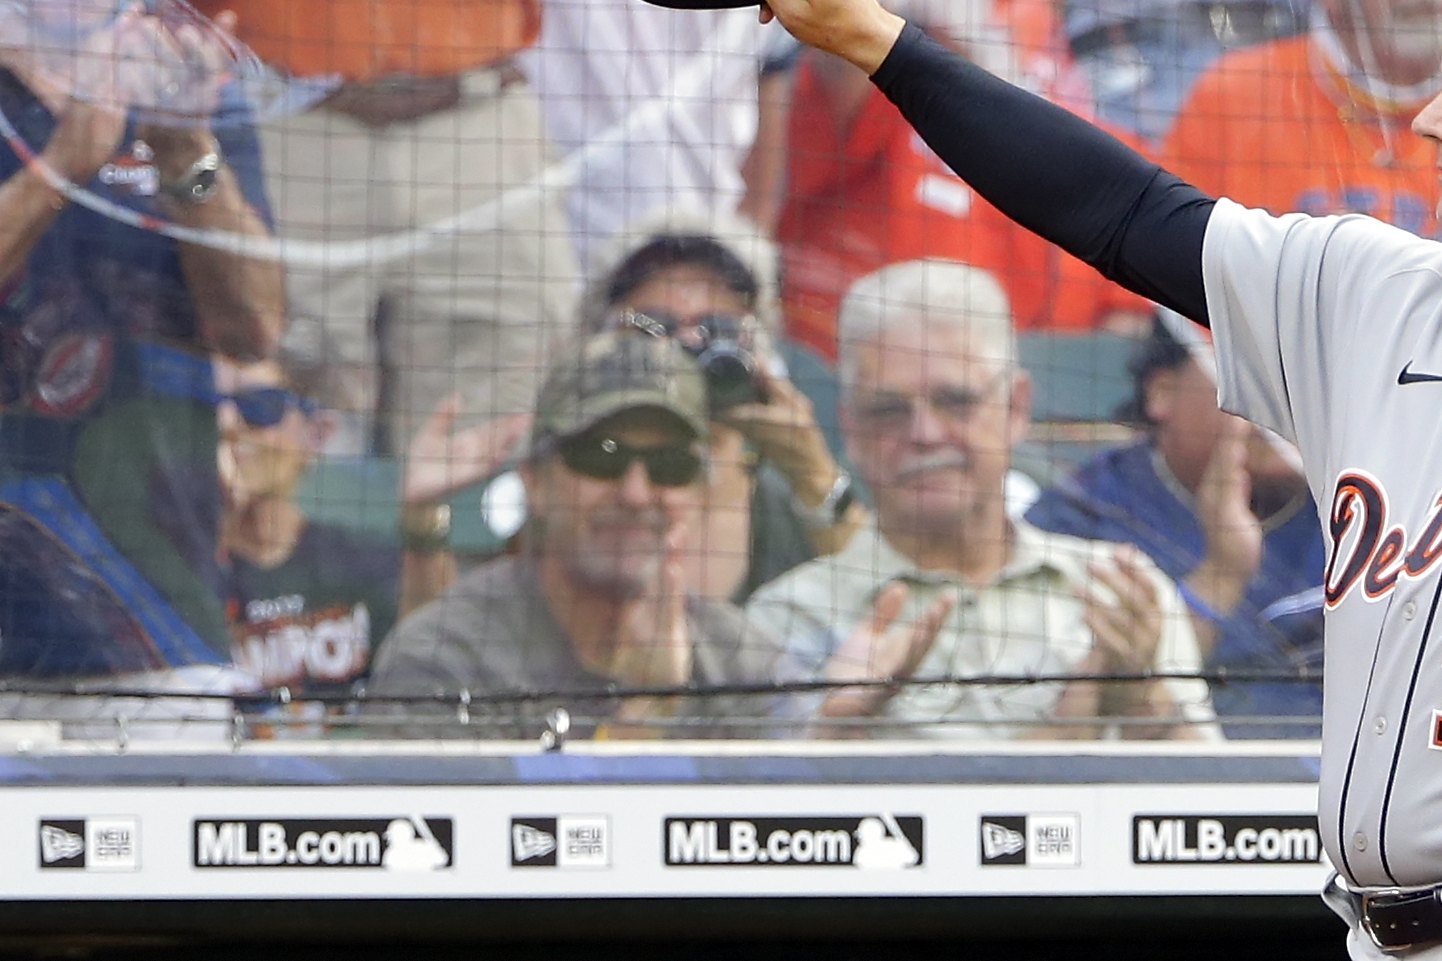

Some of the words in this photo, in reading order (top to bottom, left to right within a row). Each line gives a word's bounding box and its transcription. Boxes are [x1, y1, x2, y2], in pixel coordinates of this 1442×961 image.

[198, 822, 380, 865] MLB.com
[669, 821, 850, 863] MLB.com
[1138, 819, 1318, 861] MLB.com
